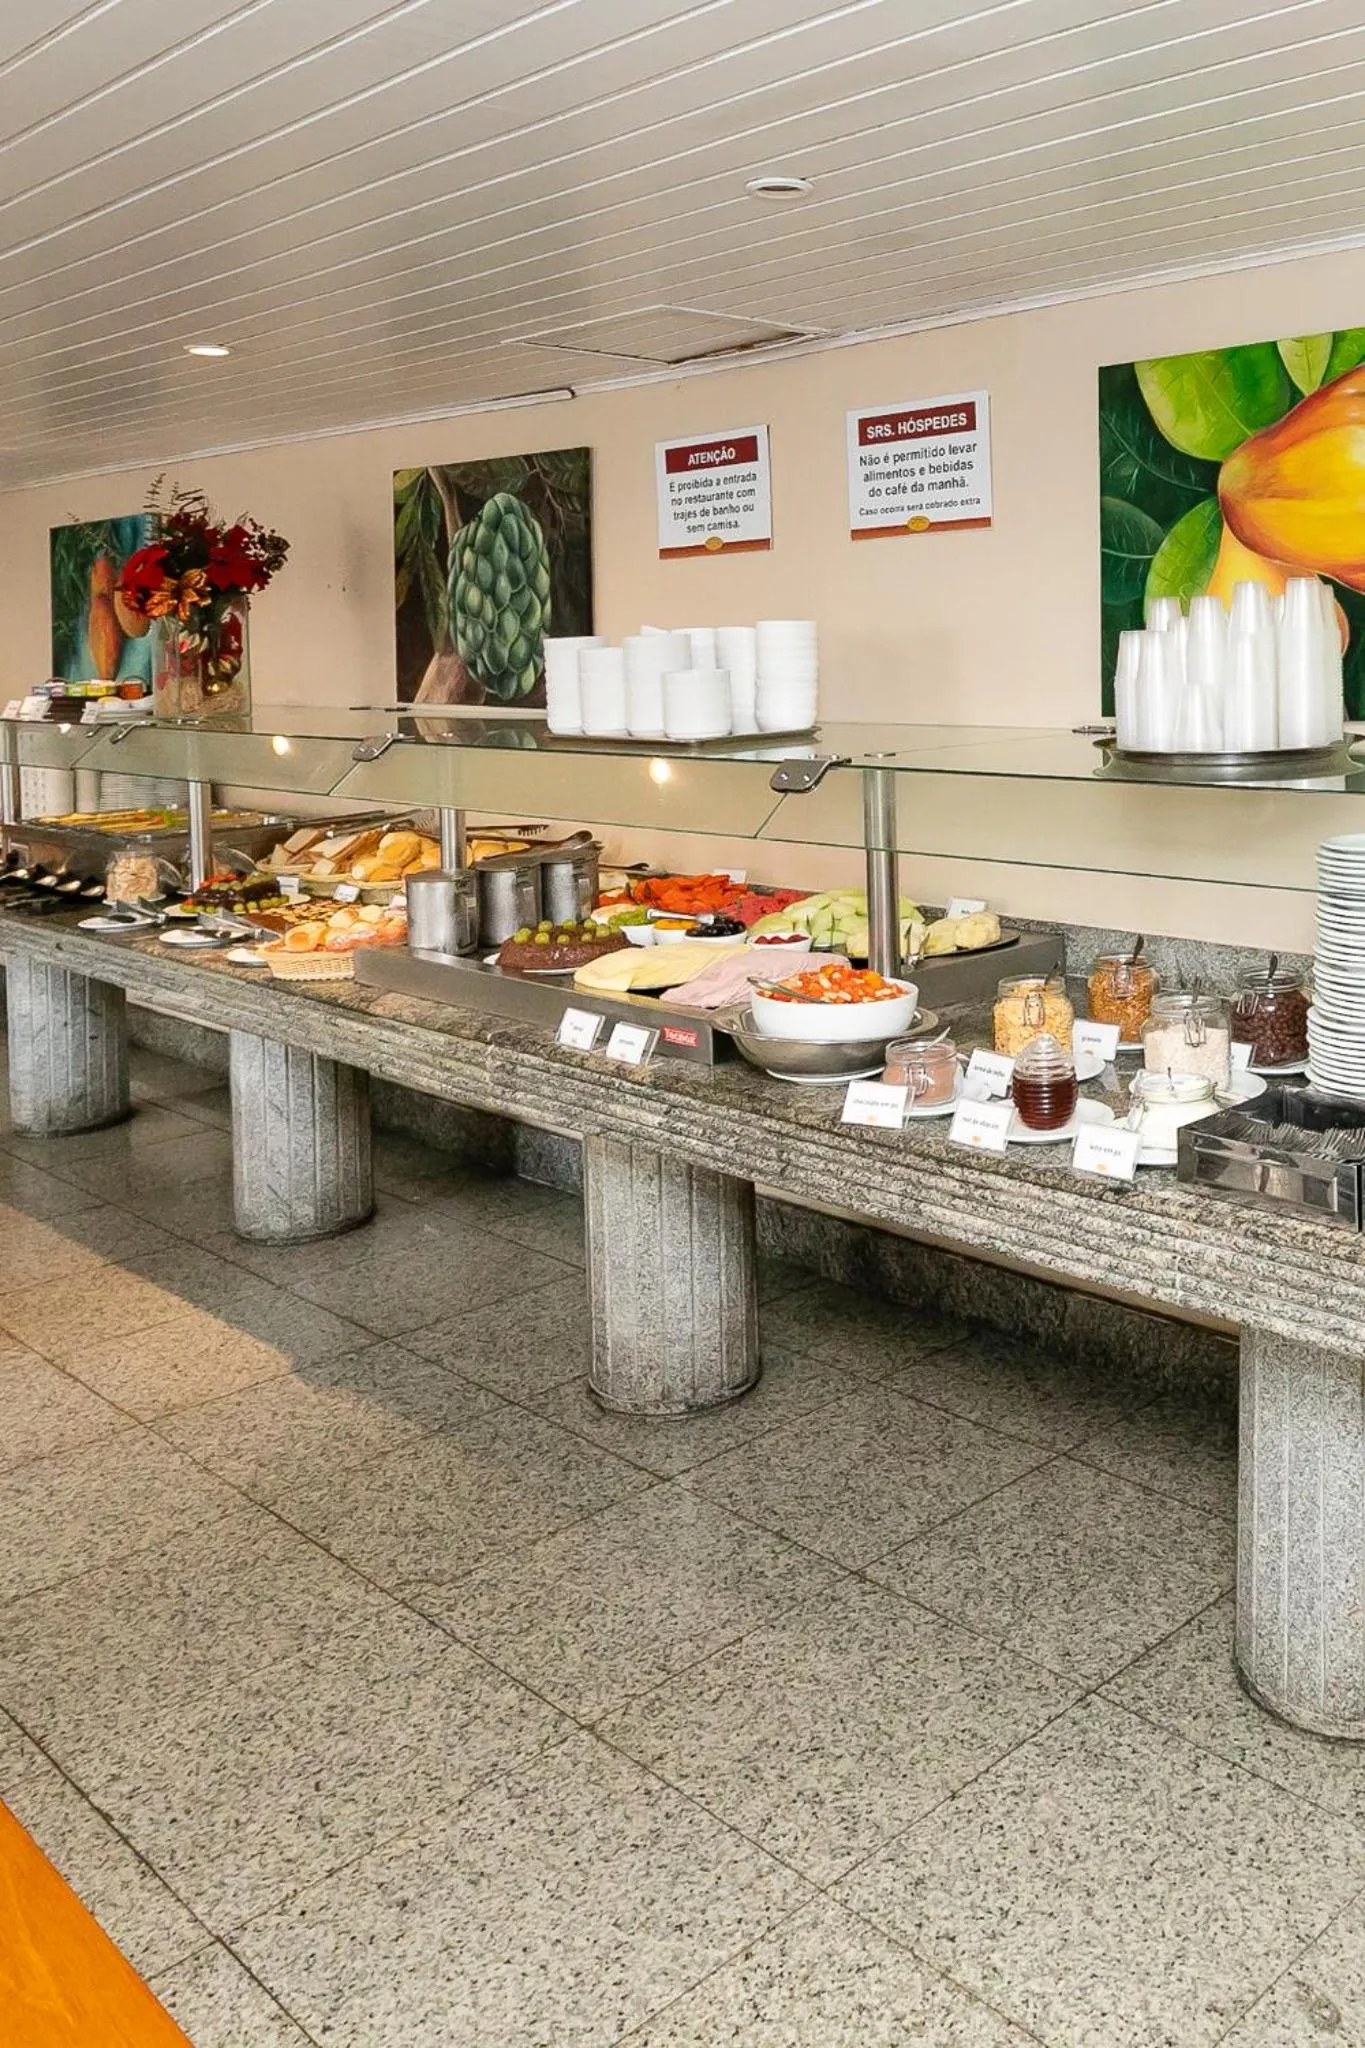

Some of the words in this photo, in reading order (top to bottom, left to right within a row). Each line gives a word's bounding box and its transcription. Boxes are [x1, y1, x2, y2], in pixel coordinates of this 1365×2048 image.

[867, 425, 895, 439] SRS.
[898, 413, 967, 434] HÓSPEDES
[688, 446, 735, 465] ATENÇÃO
[859, 455, 880, 466] Não
[884, 454, 889, 463] é
[893, 447, 945, 464] permitido
[949, 443, 977, 455] levar
[864, 467, 915, 482] alimentos
[919, 467, 925, 476] e
[929, 460, 973, 474] bebidas
[678, 477, 713, 493] proibida
[723, 471, 757, 485] entrada
[869, 488, 882, 497] do
[886, 483, 907, 495] café
[911, 482, 924, 493] da
[928, 476, 968, 491] manhã.
[671, 497, 682, 506] no
[685, 491, 733, 504] restaurante
[737, 488, 756, 497] com
[859, 507, 878, 516] Caso
[907, 502, 923, 511] será
[925, 499, 958, 510] cobrado
[961, 497, 980, 506] extra
[674, 510, 697, 521] trajes
[700, 507, 710, 517] de
[713, 504, 740, 515] banho
[743, 504, 754, 512] ou
[687, 523, 704, 533] sem
[707, 520, 740, 531] camisa.
